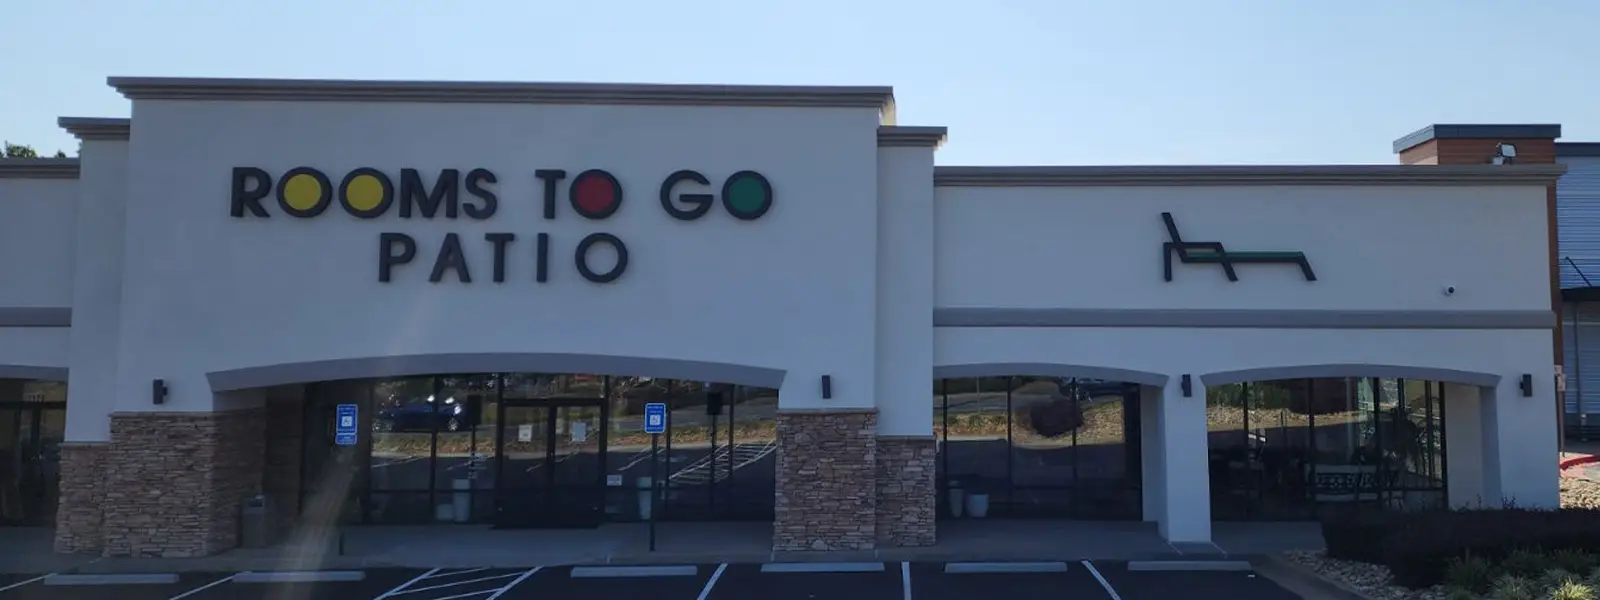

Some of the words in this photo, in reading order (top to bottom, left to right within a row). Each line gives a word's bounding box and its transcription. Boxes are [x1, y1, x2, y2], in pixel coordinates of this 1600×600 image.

[230, 166, 498, 219] ROOMS
[535, 168, 623, 220] TO
[659, 170, 774, 221] GO
[378, 232, 629, 284] PATIO
